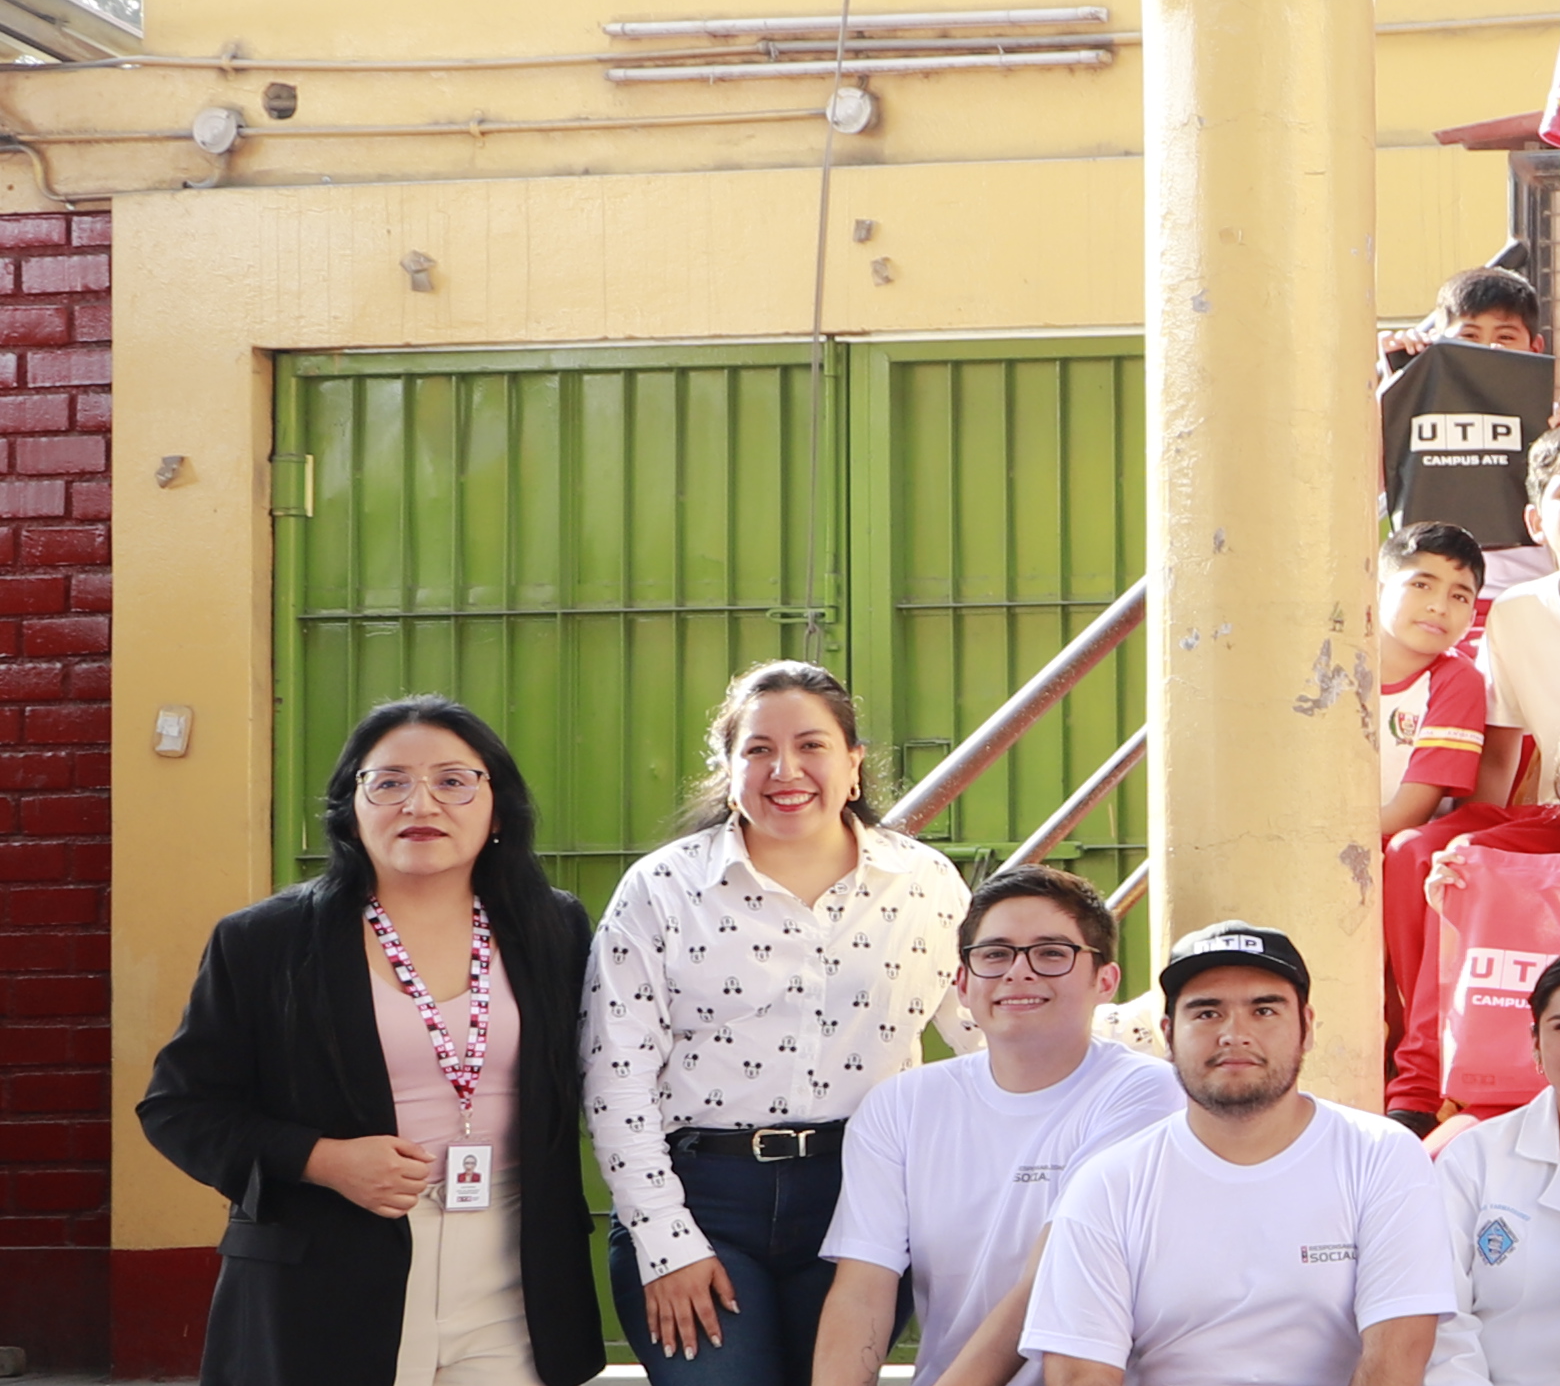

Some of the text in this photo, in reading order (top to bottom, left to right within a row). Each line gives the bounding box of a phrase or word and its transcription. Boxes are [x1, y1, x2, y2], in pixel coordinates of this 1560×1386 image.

[1416, 422, 1513, 443] UTP
[1422, 454, 1509, 466] CAMPUS ATE
